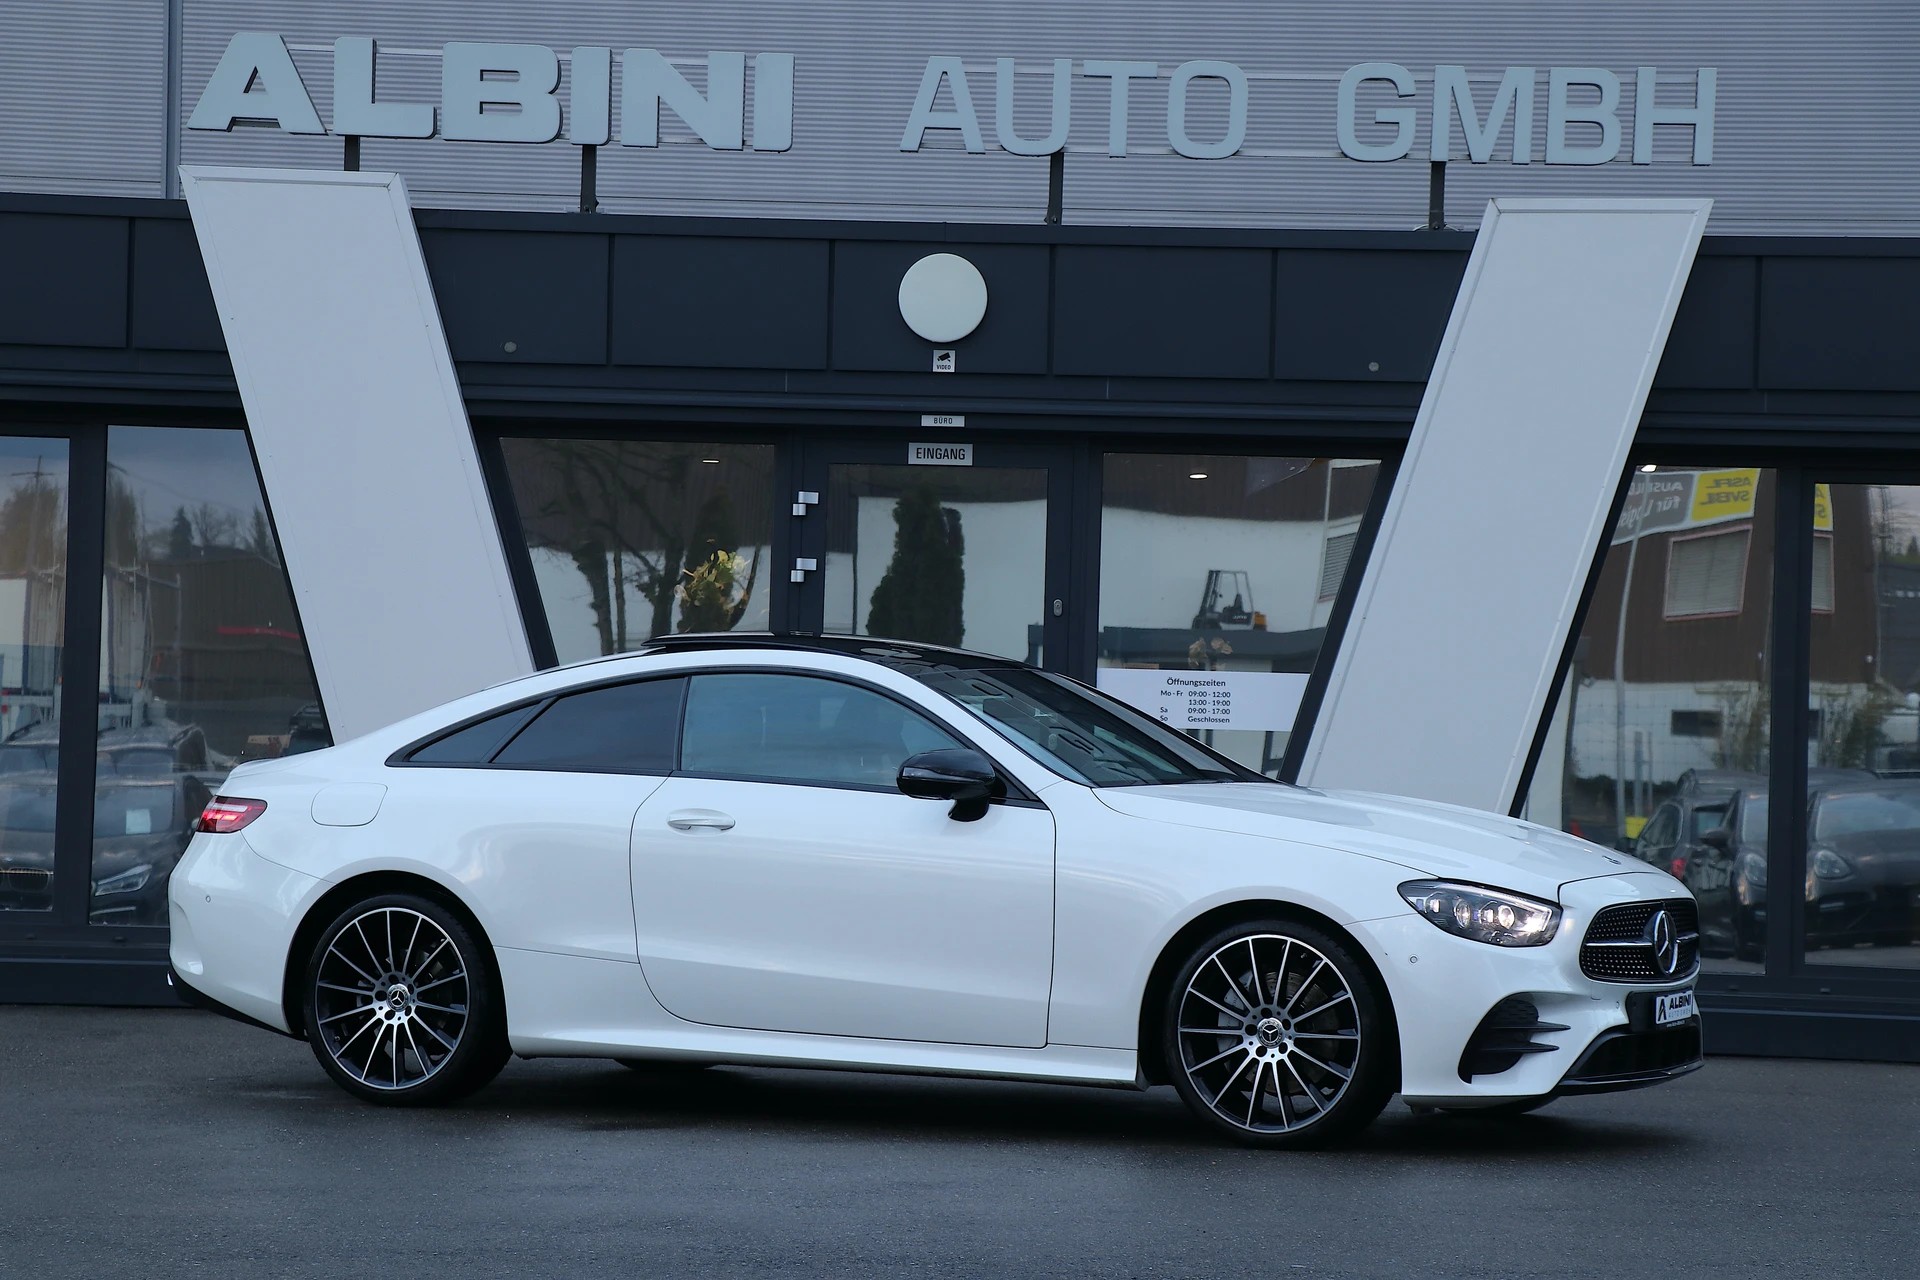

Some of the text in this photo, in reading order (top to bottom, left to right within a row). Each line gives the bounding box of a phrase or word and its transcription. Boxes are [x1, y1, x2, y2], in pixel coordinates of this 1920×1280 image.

[187, 31, 1718, 167] ALBINI AUTO GMBH
[933, 416, 953, 425] BÜRO
[916, 447, 966, 461] EINGANG
[1166, 677, 1226, 688] Öffnungszeiten
